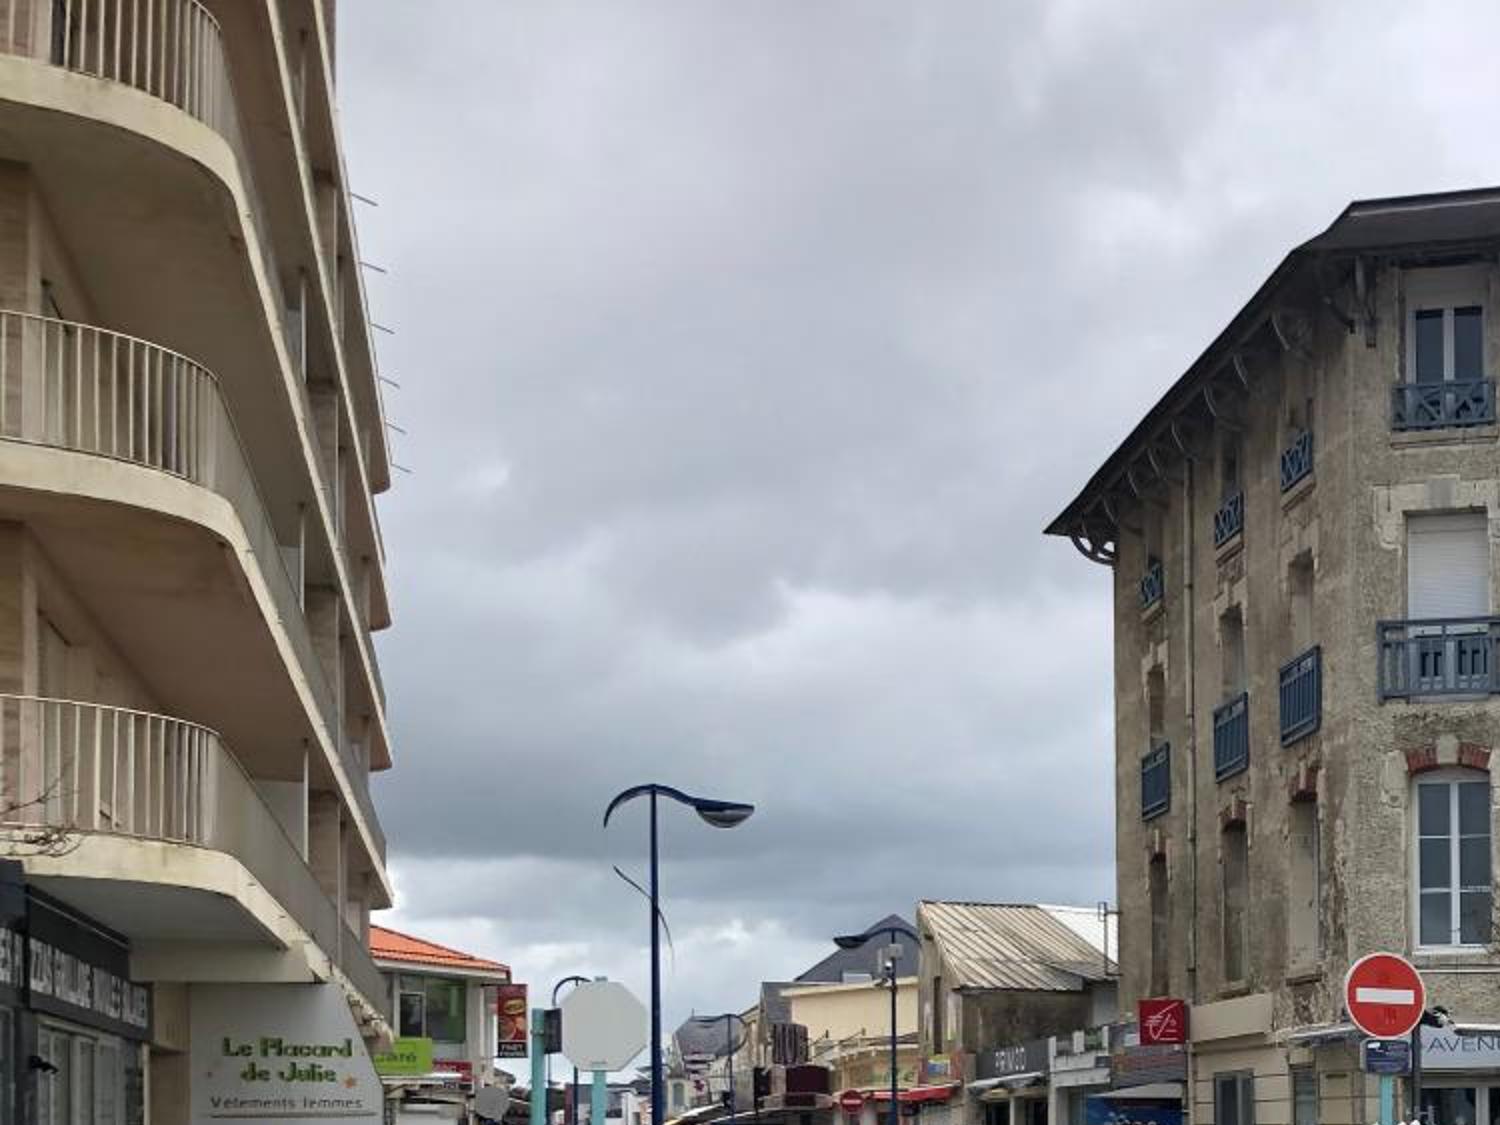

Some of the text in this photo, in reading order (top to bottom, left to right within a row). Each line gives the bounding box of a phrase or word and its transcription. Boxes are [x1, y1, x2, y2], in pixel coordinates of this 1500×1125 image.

[223, 1037, 353, 1057] Le Placard
[240, 1061, 337, 1082] de Julie
